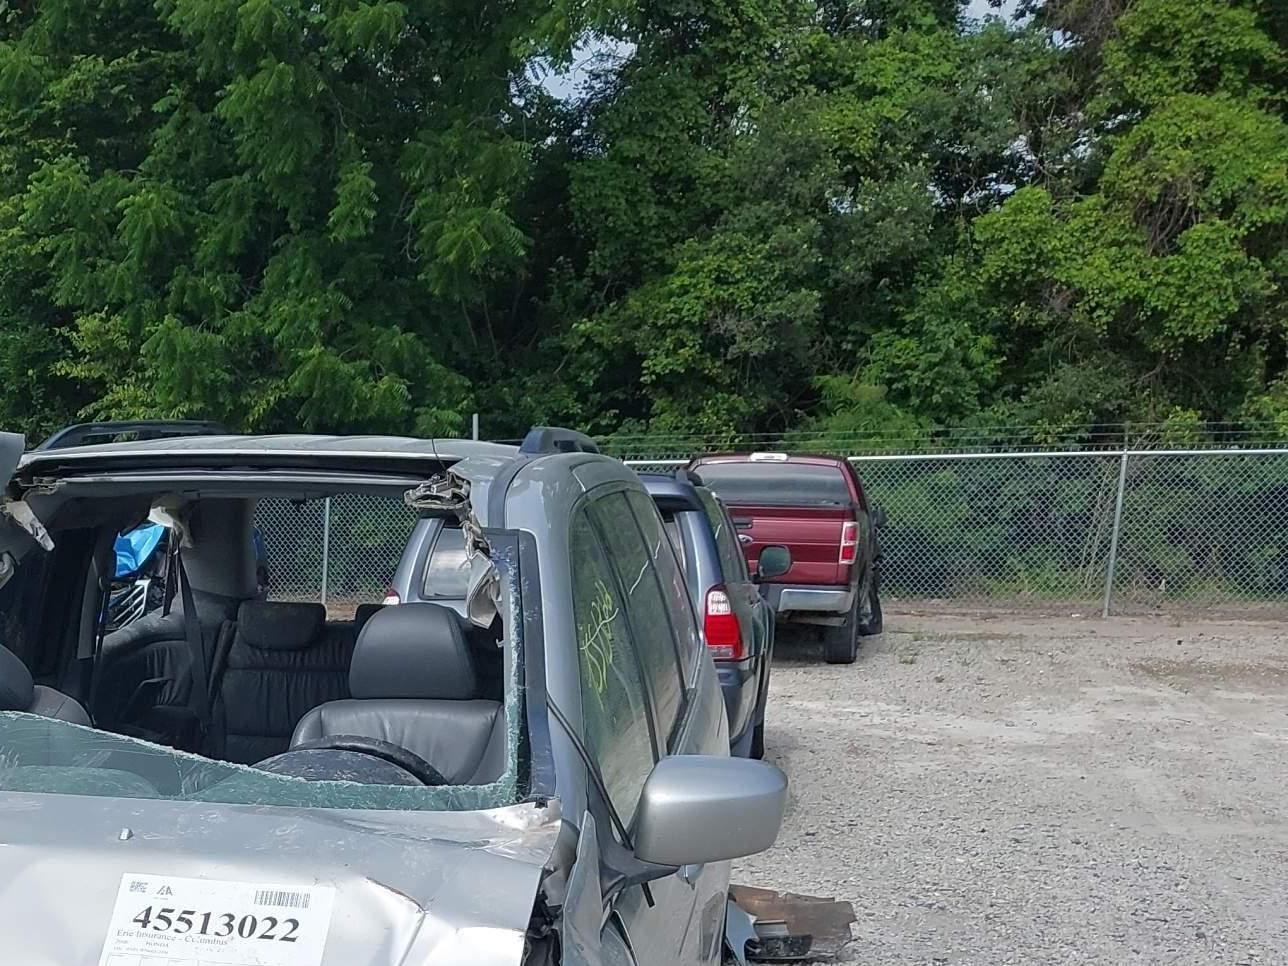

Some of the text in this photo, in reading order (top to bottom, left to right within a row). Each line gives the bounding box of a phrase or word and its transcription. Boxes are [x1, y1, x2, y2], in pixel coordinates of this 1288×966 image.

[116, 929, 134, 939] Erie
[135, 930, 177, 942] Insurance
[132, 905, 300, 943] 45513022
